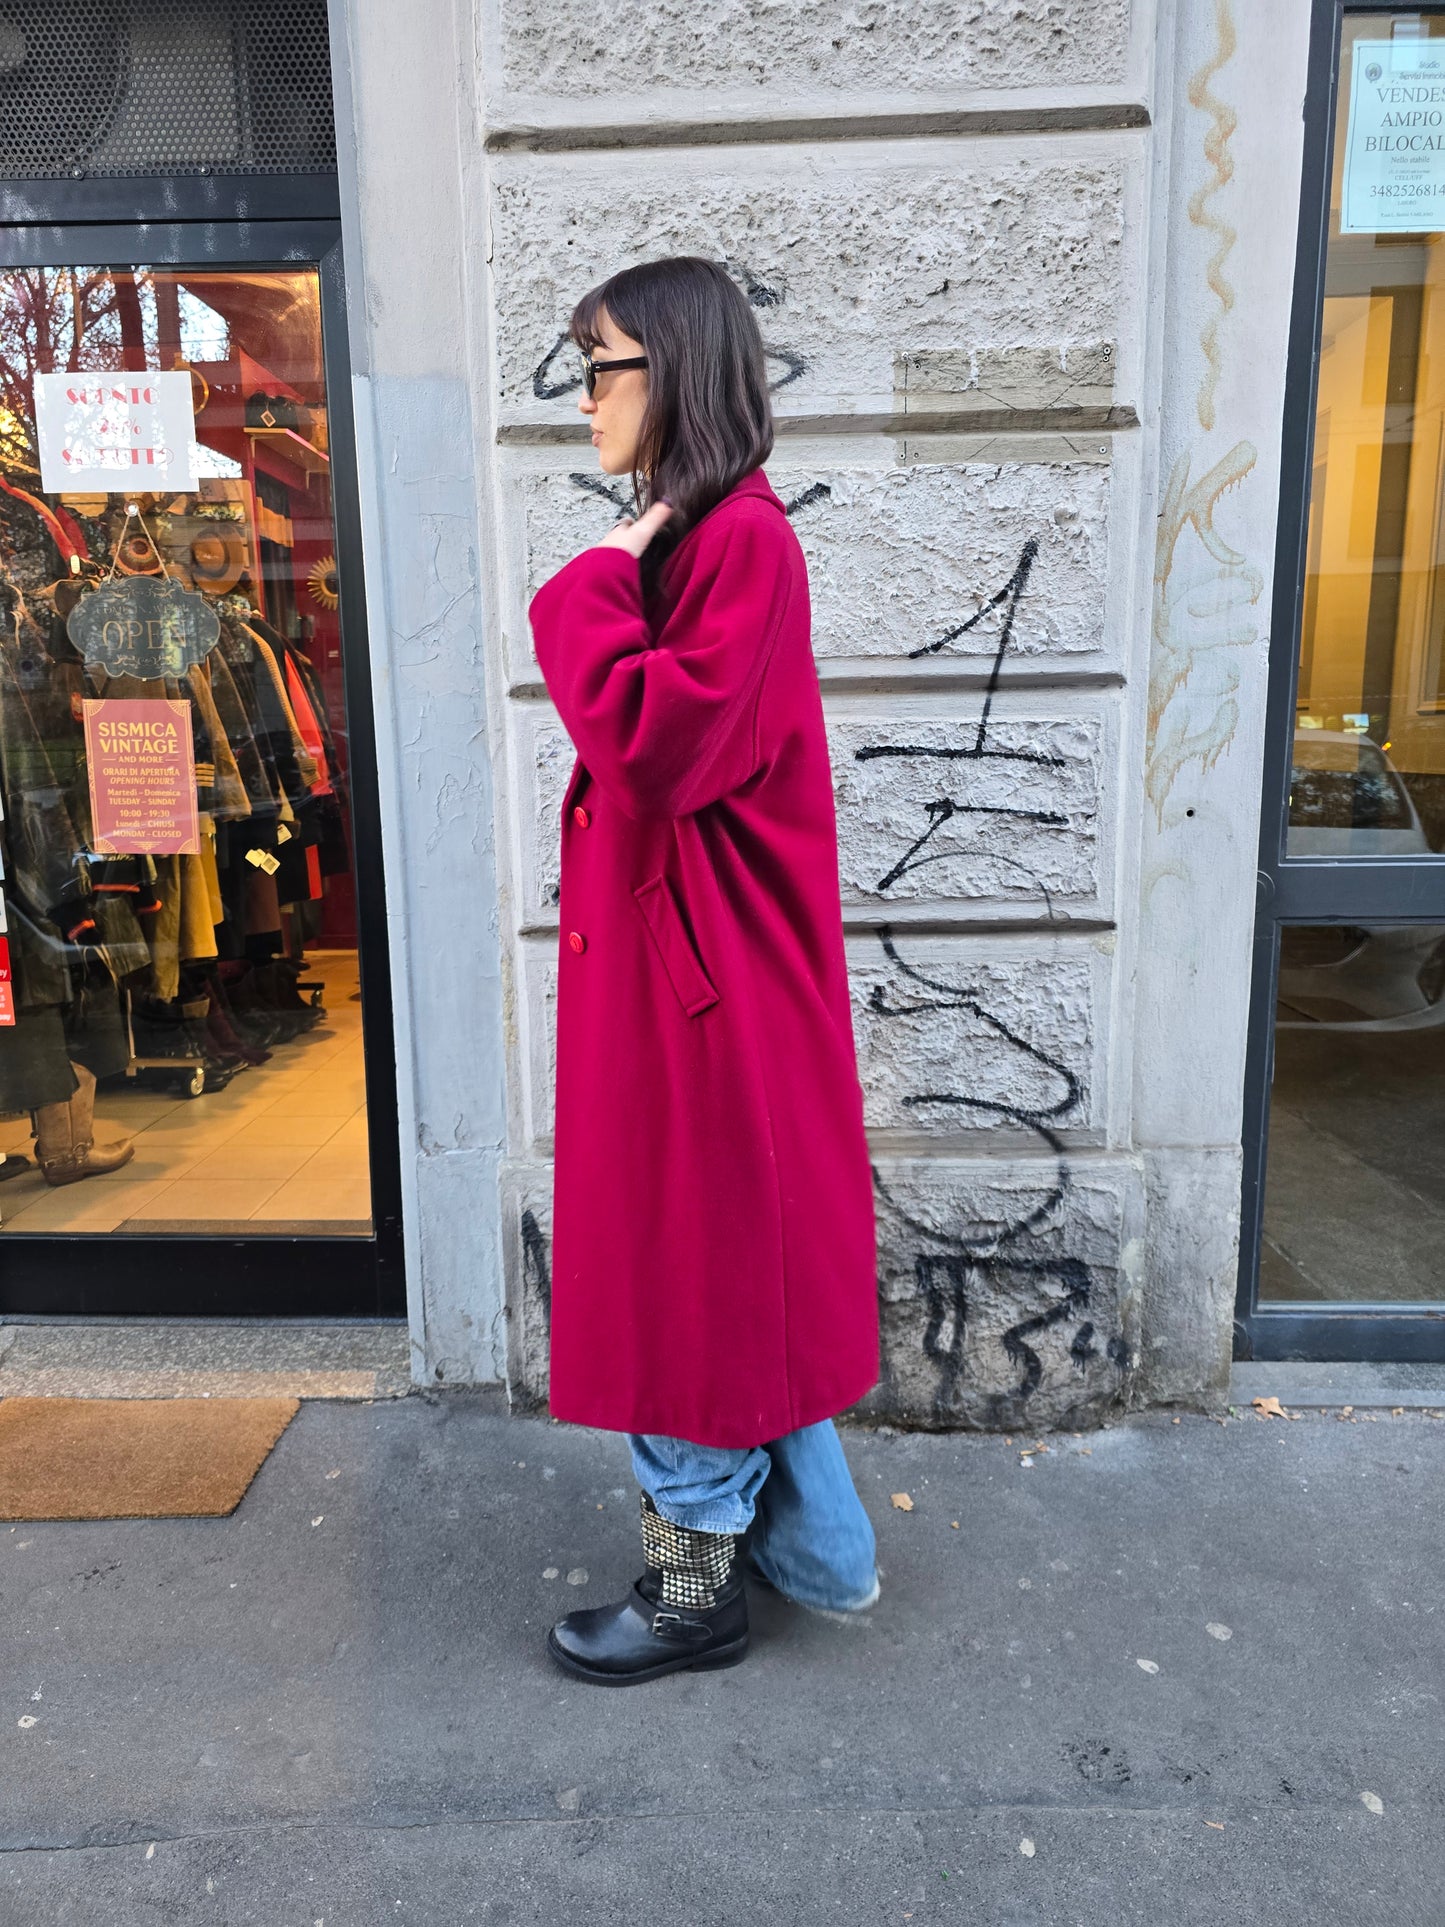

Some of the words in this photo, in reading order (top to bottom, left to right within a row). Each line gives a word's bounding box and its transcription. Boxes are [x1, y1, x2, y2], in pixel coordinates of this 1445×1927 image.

[1381, 111, 1442, 127] AMPIO
[1365, 135, 1445, 152] BILOCAL
[102, 620, 187, 650] OPEN
[98, 722, 177, 737] SISMICA
[100, 739, 179, 754] VINTAGE
[103, 768, 128, 776] ORARI
[129, 768, 138, 776] DI
[140, 767, 180, 776] APERTURA
[110, 777, 145, 785] OPENING
[147, 777, 175, 785] HOURS
[144, 788, 181, 797] Domenica
[109, 797, 140, 805] TUESDAY
[148, 798, 176, 806] SUNDAY
[120, 809, 142, 817] 10:00
[149, 809, 170, 818] 19:30
[147, 820, 175, 828] CHIUSI
[113, 829, 146, 837] MONDAY
[152, 830, 182, 838] CLOSED
